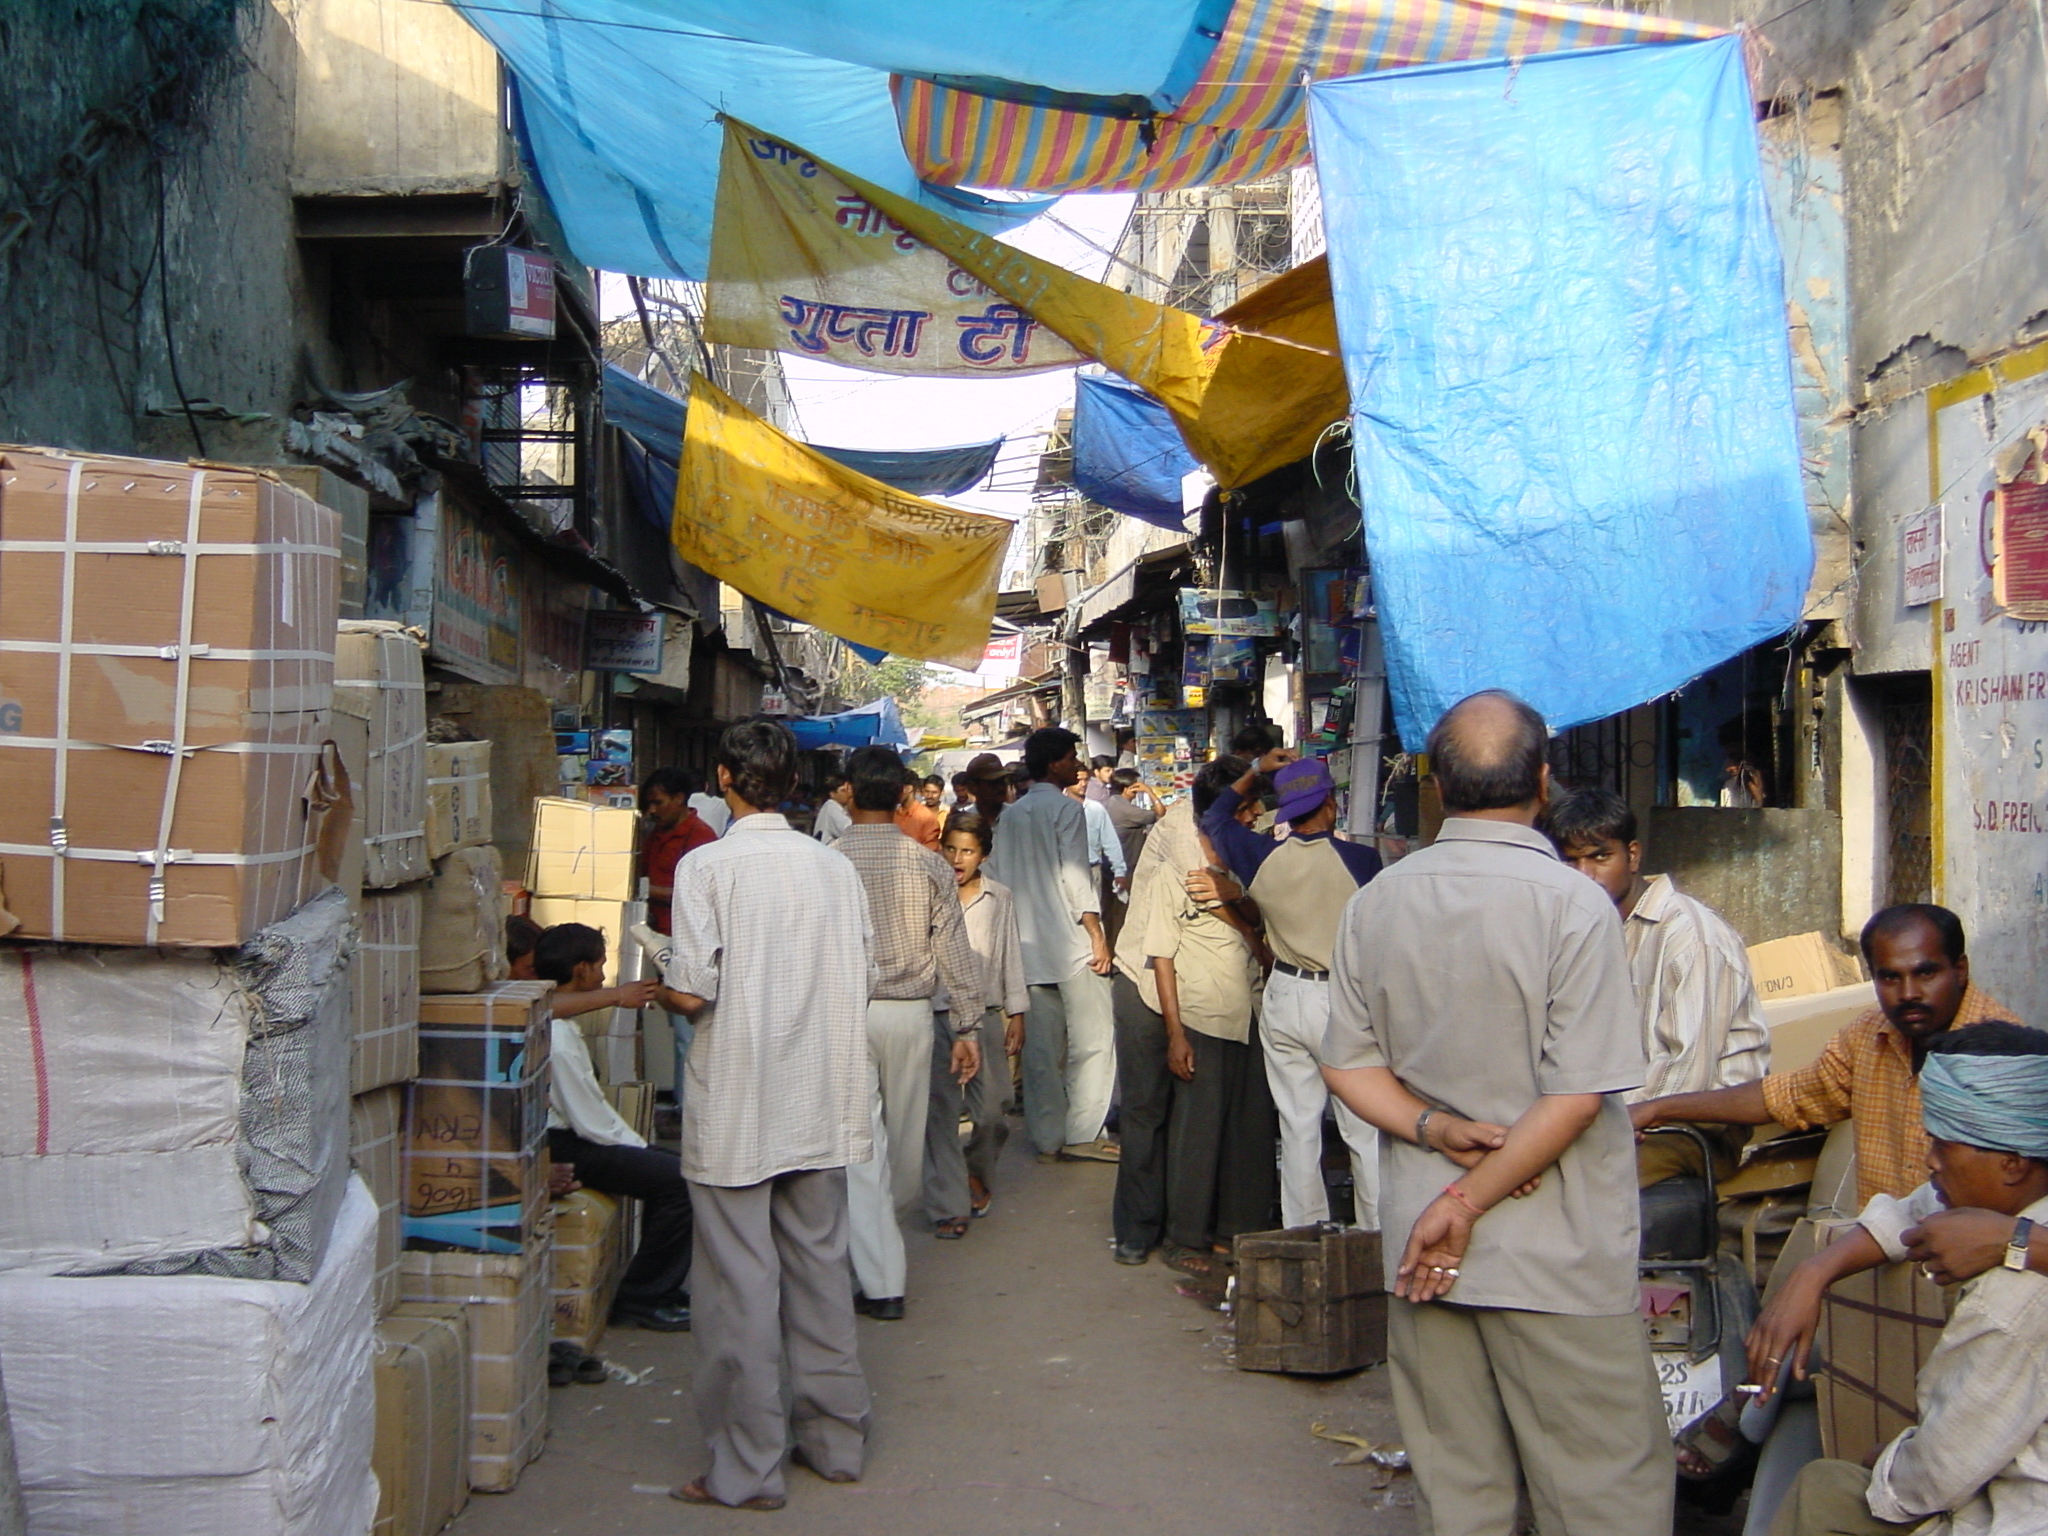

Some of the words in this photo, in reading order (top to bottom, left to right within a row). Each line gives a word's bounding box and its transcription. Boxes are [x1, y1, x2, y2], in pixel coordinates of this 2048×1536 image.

[780, 294, 931, 355] गुप्ता
[956, 302, 1039, 365] टी
[988, 646, 1016, 659] only!
[1949, 639, 1981, 668] AGENT
